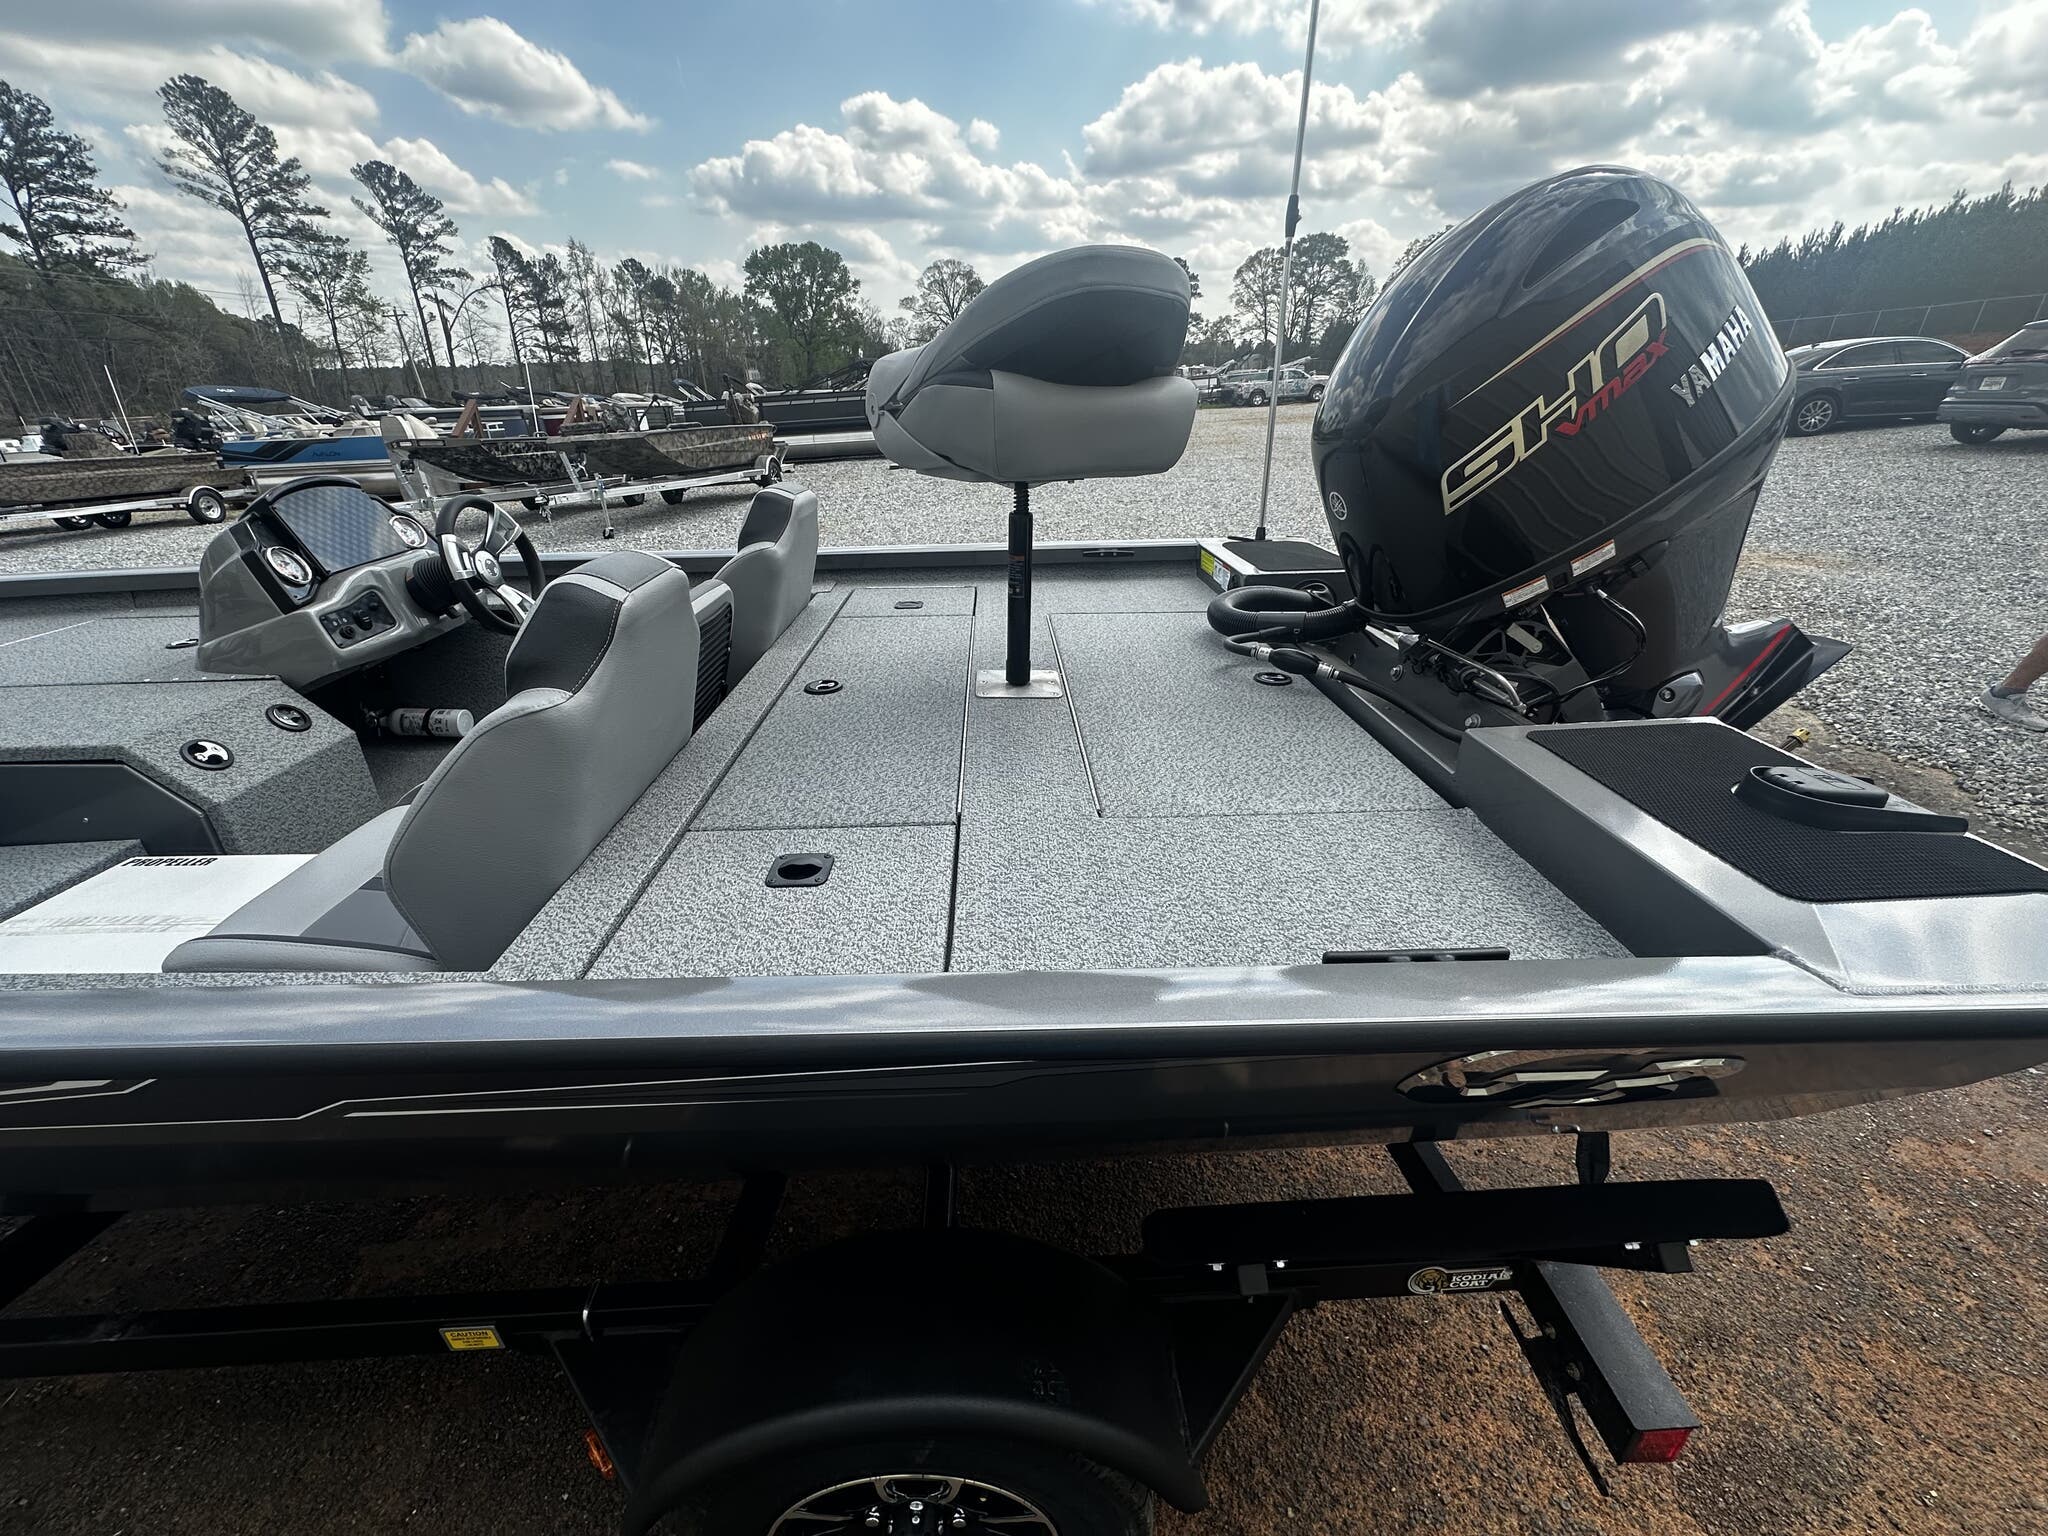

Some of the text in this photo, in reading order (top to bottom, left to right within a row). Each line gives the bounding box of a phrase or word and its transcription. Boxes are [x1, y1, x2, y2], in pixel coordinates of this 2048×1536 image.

[1670, 304, 1752, 408] YAMAHA
[1441, 292, 1667, 516] SHO
[120, 856, 218, 867] PROPELLER
[1449, 1279, 1488, 1288] COAT
[450, 1330, 488, 1338] CAUTION
